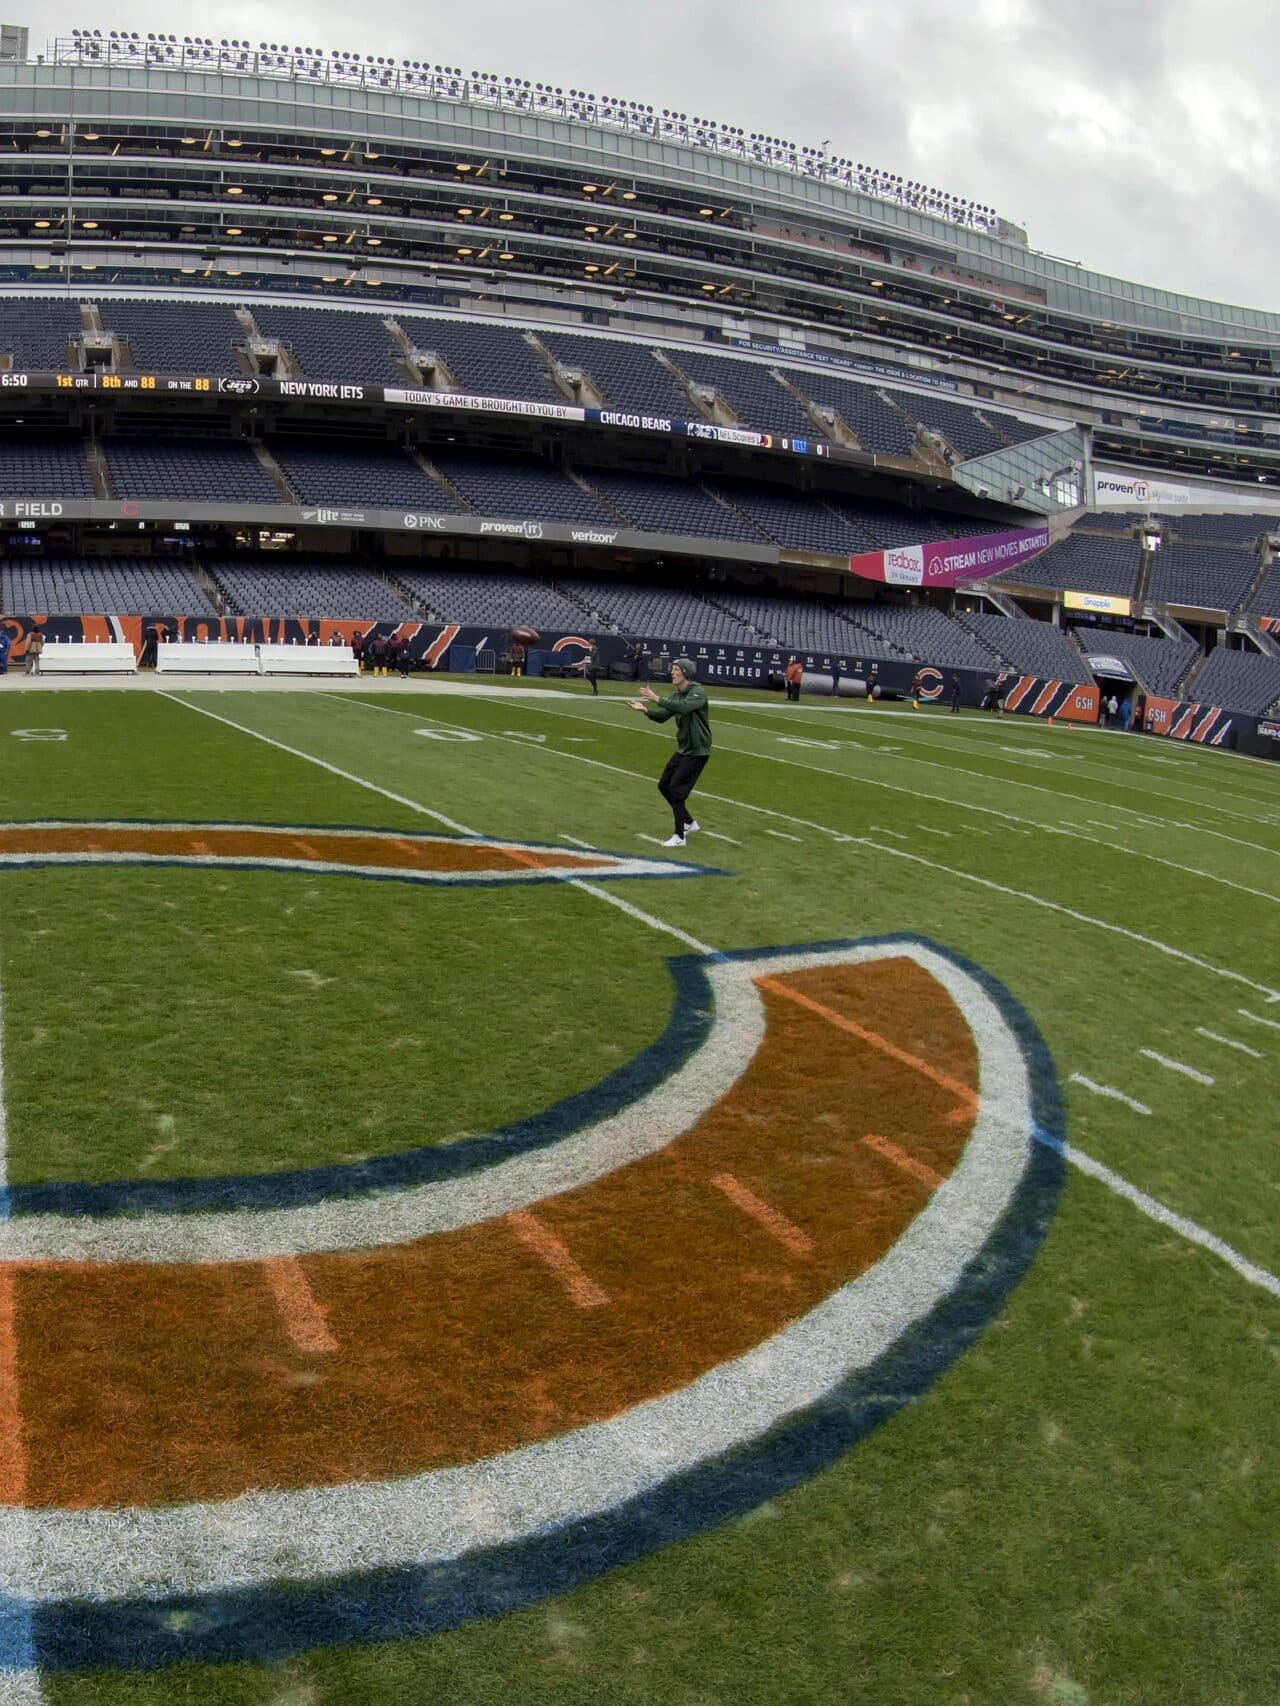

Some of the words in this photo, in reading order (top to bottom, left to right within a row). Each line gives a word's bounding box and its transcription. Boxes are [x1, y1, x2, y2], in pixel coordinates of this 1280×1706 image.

[738, 340, 751, 348] FOR
[1, 375, 28, 387] 6:50
[56, 375, 73, 387] 1st
[75, 378, 89, 388] QTR
[102, 375, 121, 388] 8th
[124, 379, 138, 388] AND
[141, 377, 156, 389] 88
[168, 380, 178, 390] ON
[179, 380, 192, 390] THE
[194, 378, 210, 391] 88
[280, 382, 307, 396] NEW
[308, 383, 338, 398] YORK
[340, 384, 364, 399] JETS
[404, 391, 442, 405] TODAY'S
[442, 395, 469, 408] GAME
[471, 397, 480, 408] IS
[481, 398, 523, 413] BROUGHT
[524, 403, 536, 414] TO
[537, 404, 555, 416] YOU
[556, 406, 568, 418] BY
[600, 411, 640, 428] CHICAGO
[641, 416, 671, 432] BEARS
[1097, 480, 1133, 494] proven
[15, 503, 63, 516] FIELD
[419, 516, 446, 529] PNC
[480, 521, 522, 534] proven
[571, 530, 613, 544] verizon
[944, 552, 976, 572] STREAM
[976, 549, 994, 564] NEW
[995, 543, 1018, 561] MOVIES
[1084, 597, 1111, 609] Snapple
[708, 664, 761, 678] RETIRED
[1075, 696, 1093, 711] GSH
[1149, 707, 1167, 723] GSH
